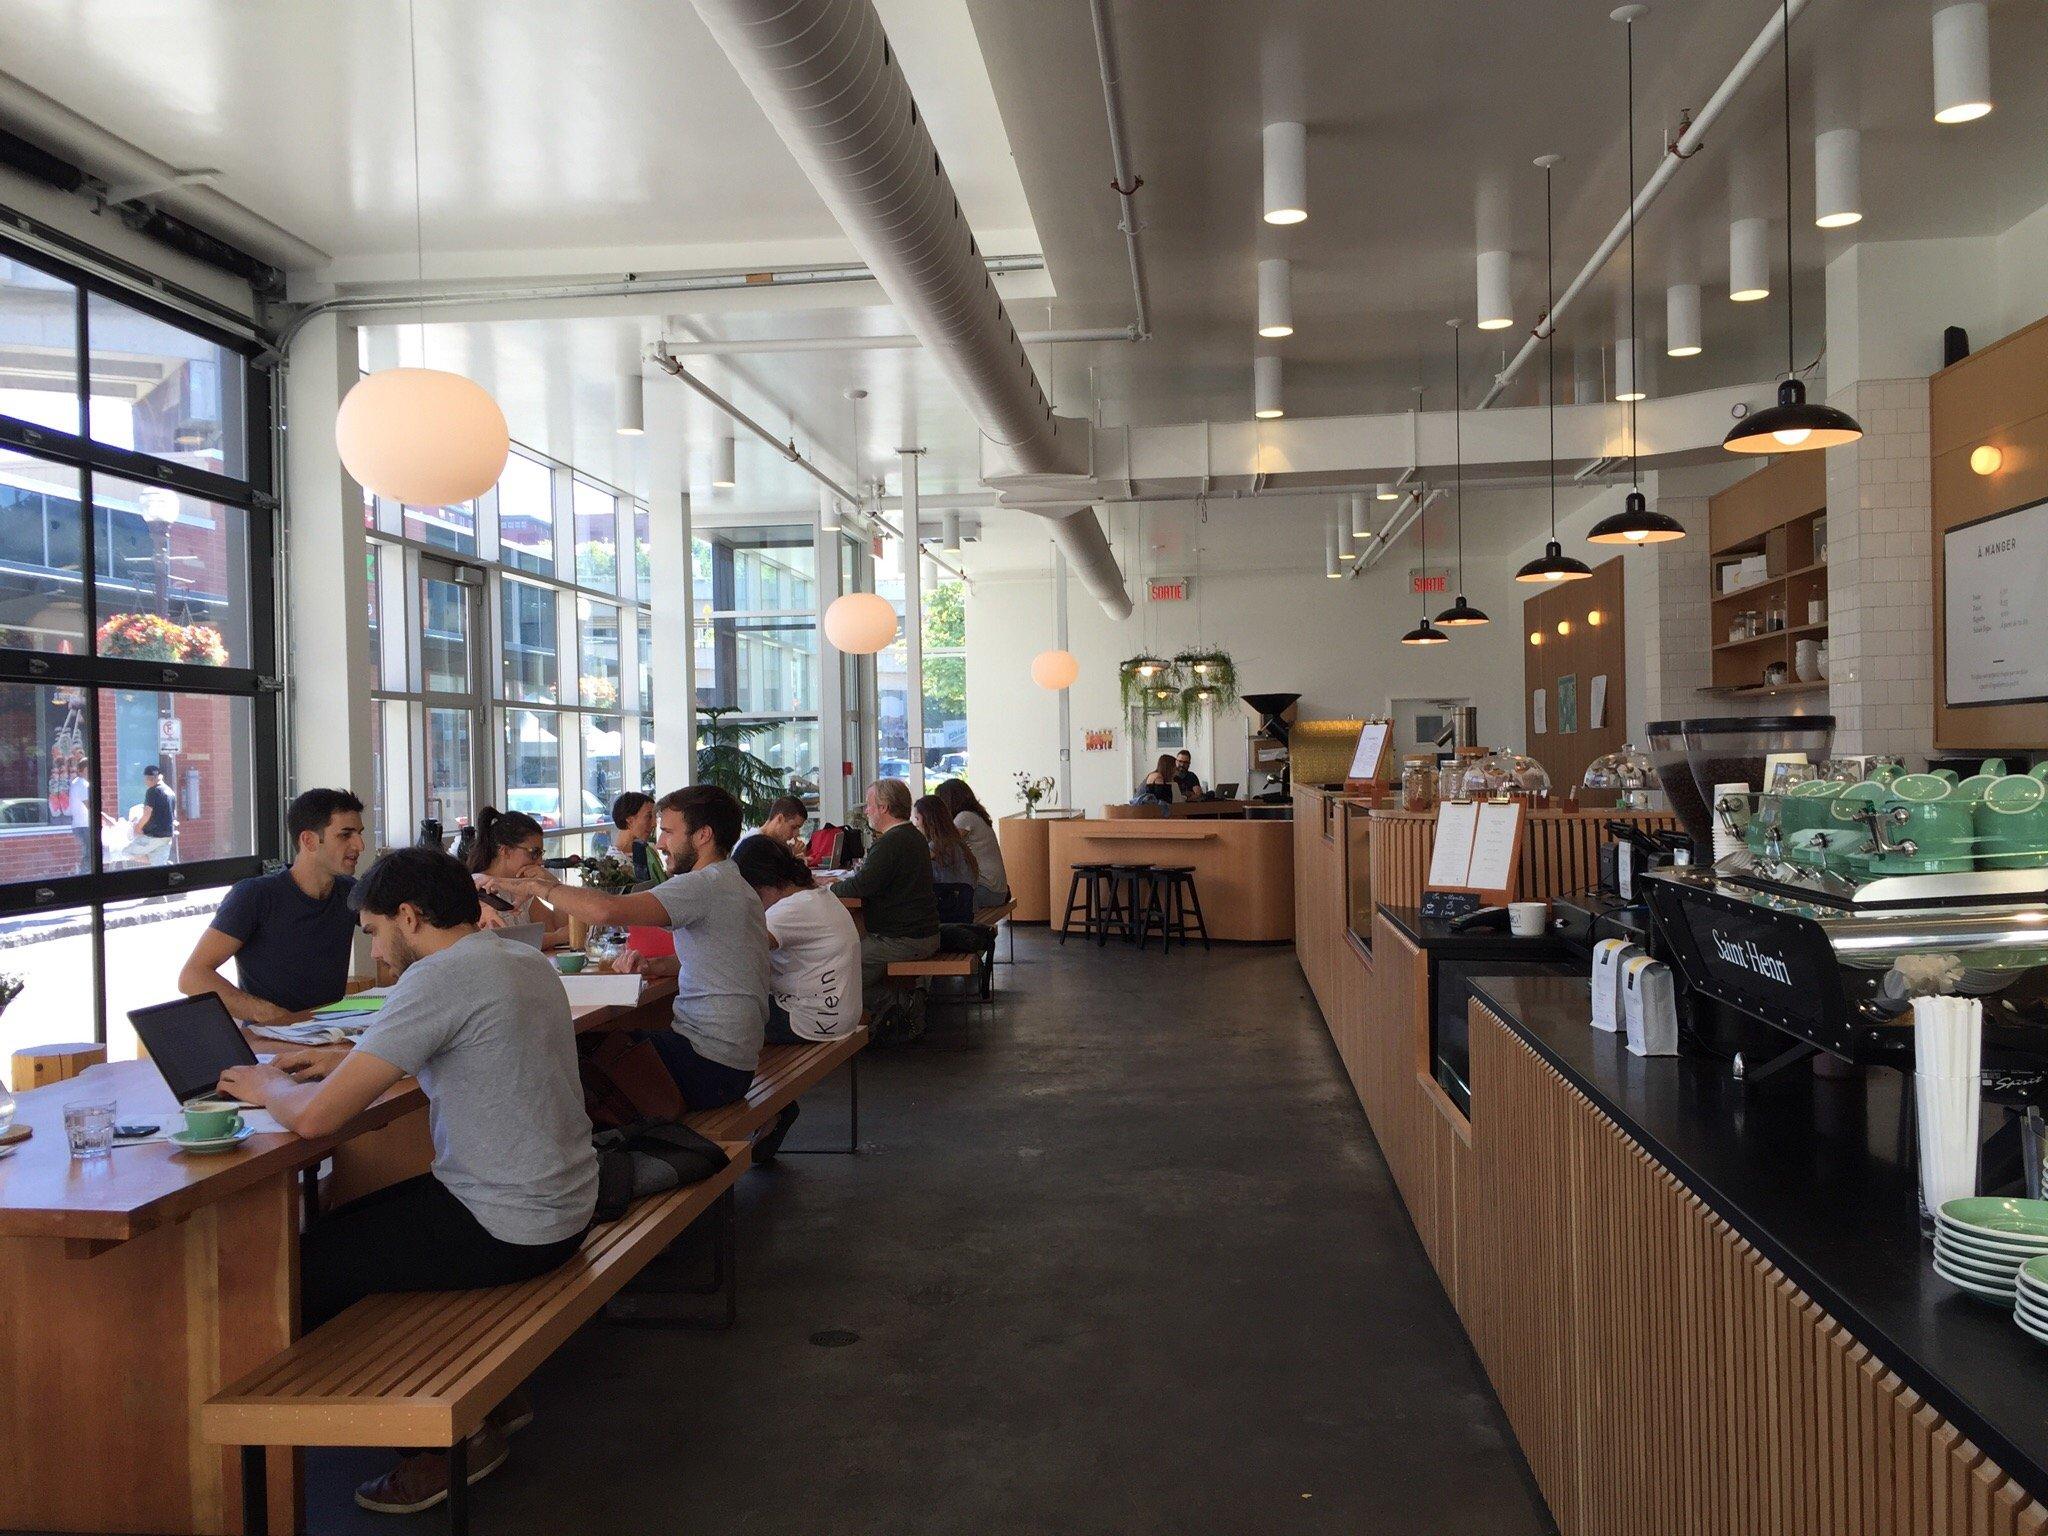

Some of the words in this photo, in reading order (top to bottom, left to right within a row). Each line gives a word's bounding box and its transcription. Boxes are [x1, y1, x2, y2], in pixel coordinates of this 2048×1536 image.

[1984, 537, 2017, 557] MANGER
[1151, 584, 1182, 601] SORTIE
[1413, 576, 1446, 592] SORTIE
[813, 969, 840, 1035] Klein
